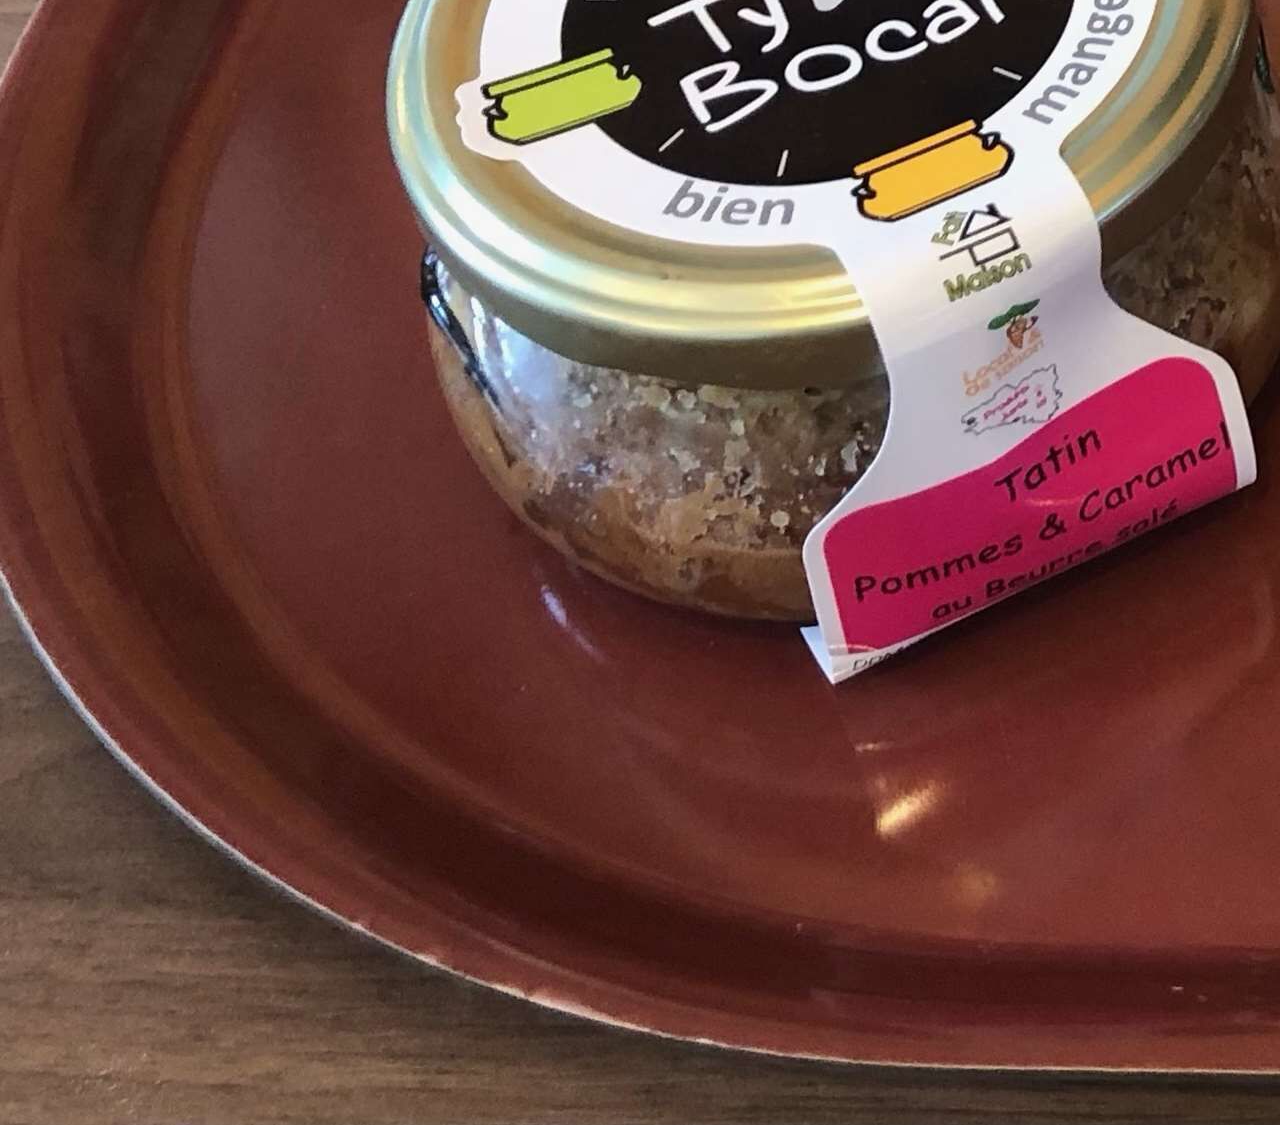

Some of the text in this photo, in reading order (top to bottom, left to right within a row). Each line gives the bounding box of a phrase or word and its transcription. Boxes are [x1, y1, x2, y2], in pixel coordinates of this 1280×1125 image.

[662, 178, 796, 228] bien
[943, 252, 1033, 302] Maison
[994, 425, 1102, 504] Tatin
[852, 421, 1232, 603] Pommes & Caramel
[931, 497, 1178, 621] au Beurre salé
